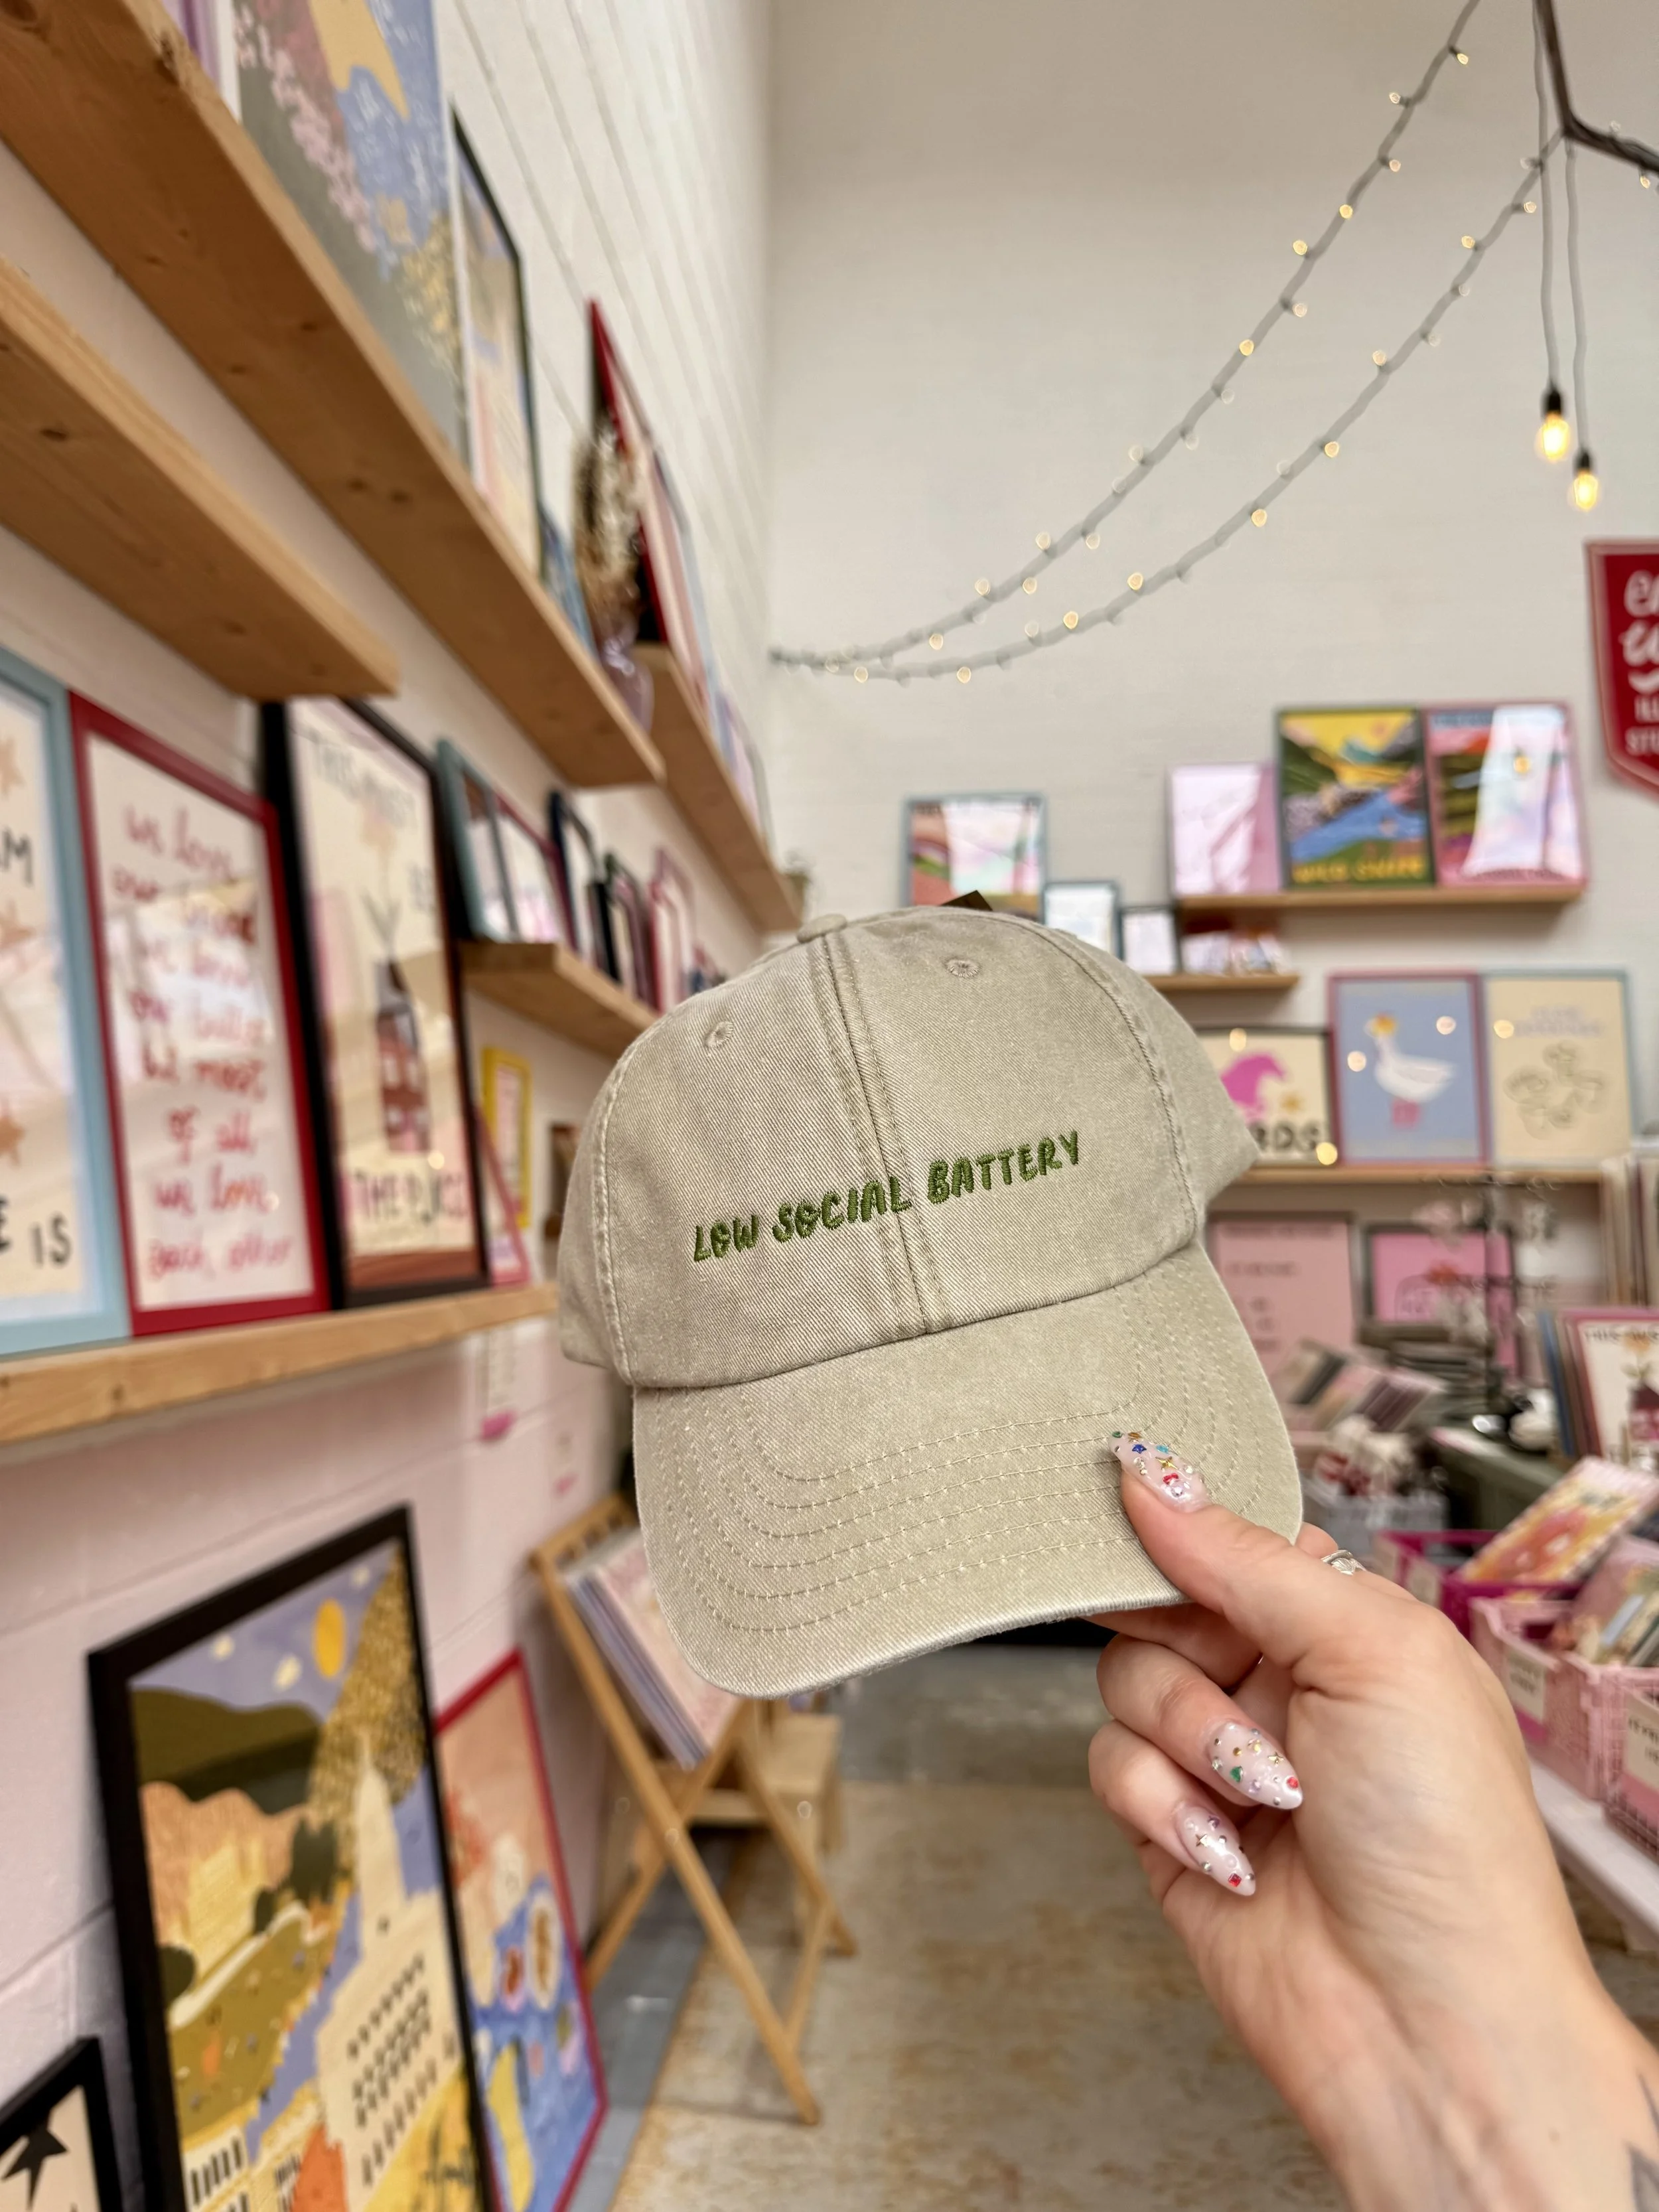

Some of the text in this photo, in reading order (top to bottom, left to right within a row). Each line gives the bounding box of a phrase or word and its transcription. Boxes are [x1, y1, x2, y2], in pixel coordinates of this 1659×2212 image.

[29, 1213, 72, 1268] IS
[693, 1130, 1078, 1262] LOW SOCIAL BATTERY
